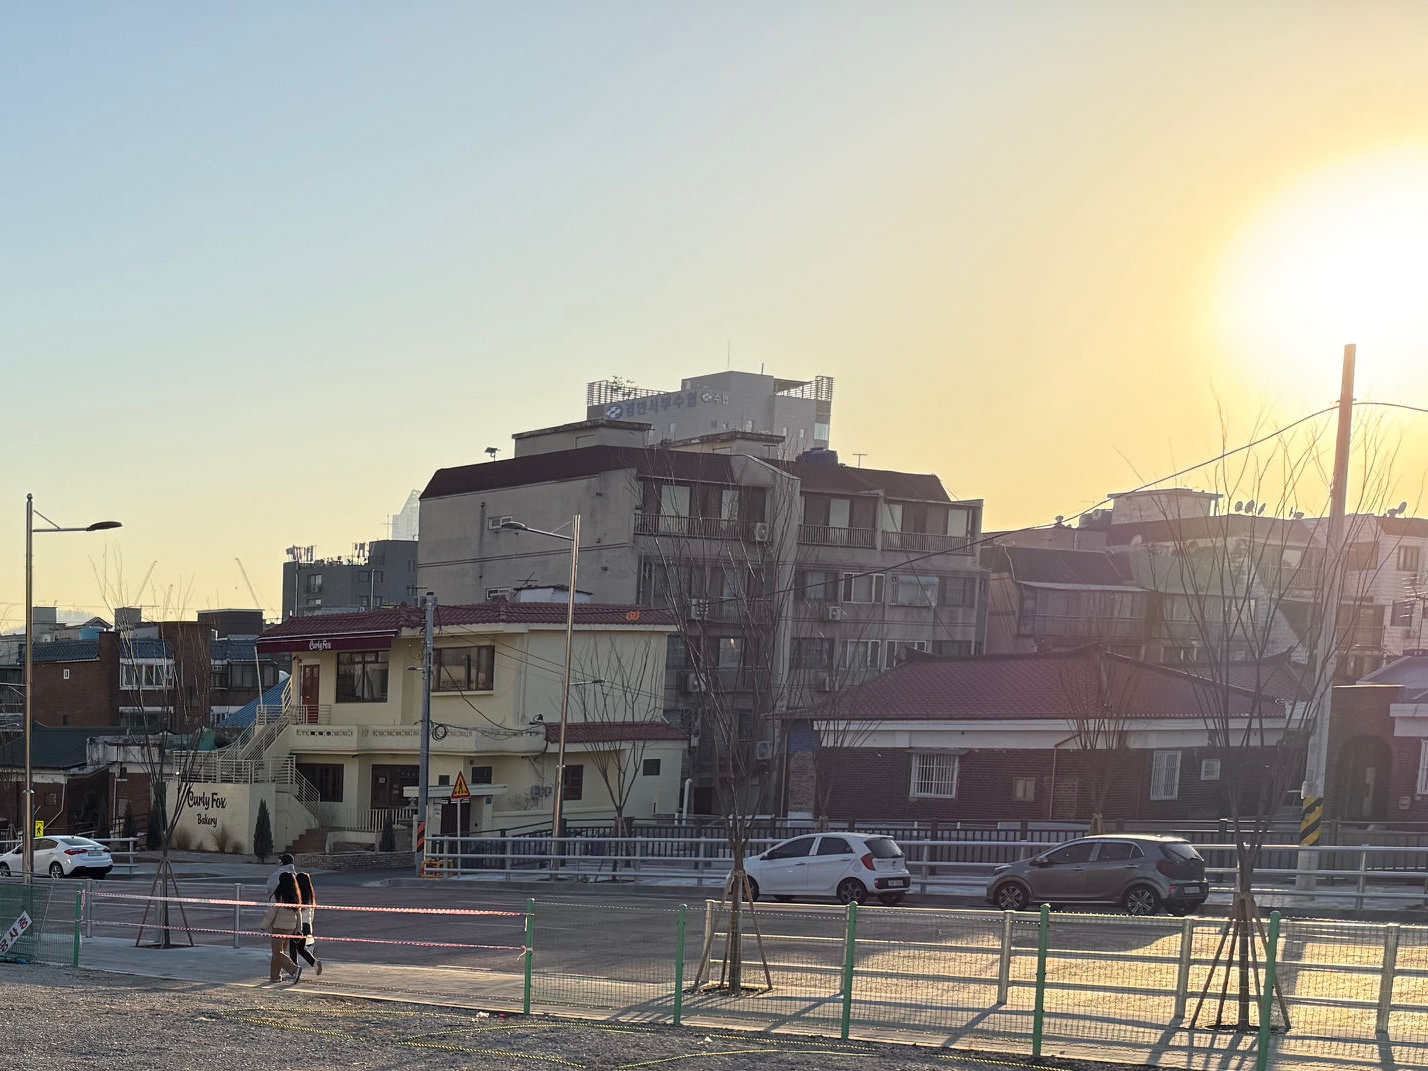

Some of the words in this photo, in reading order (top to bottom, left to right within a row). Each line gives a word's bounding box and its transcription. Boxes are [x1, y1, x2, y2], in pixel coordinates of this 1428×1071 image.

[187, 790, 210, 810] Curly
[211, 792, 228, 809] Fox
[196, 813, 218, 828] Bakery
